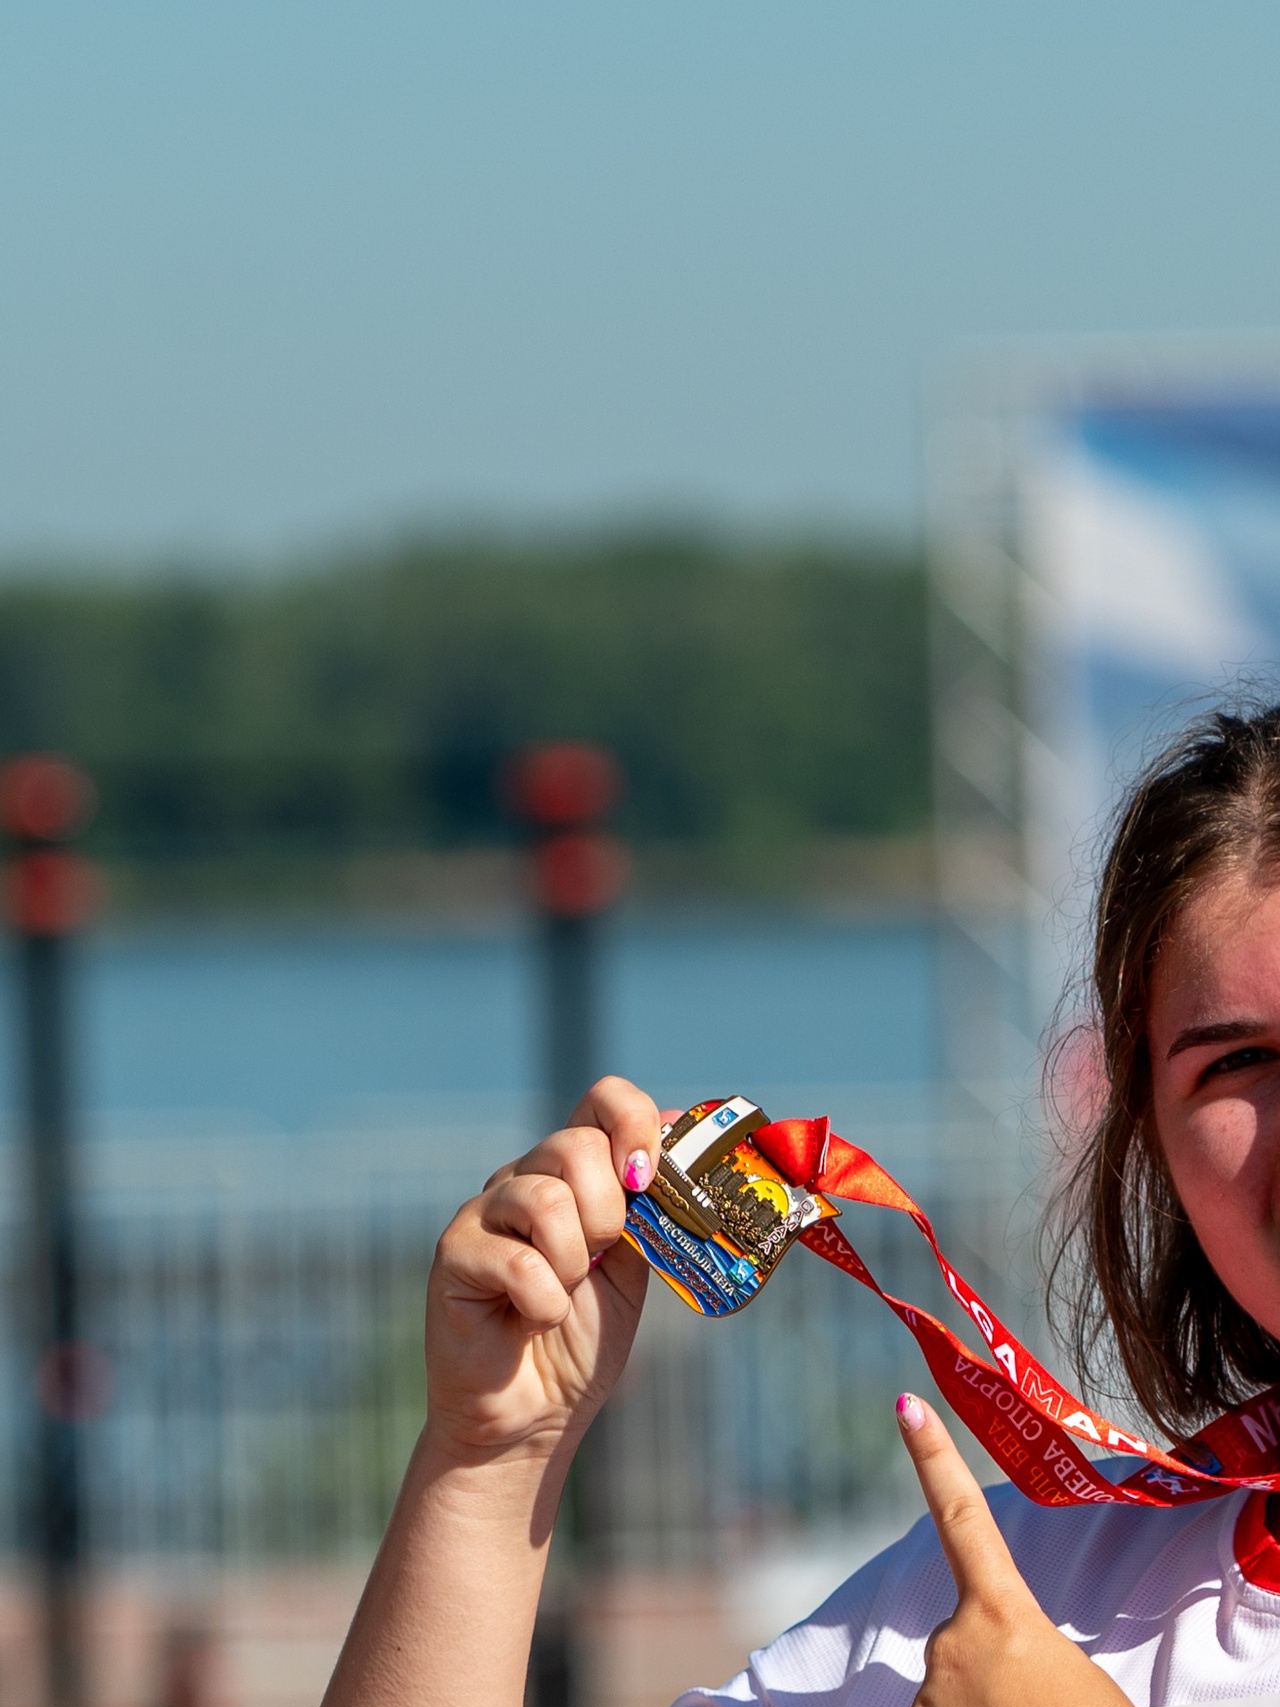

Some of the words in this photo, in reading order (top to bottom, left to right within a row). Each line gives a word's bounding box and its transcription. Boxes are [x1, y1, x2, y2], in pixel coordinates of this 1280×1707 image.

[626, 1208, 678, 1264] ОРОЛЕВА
[675, 1260, 722, 1311] СПОРТА
[658, 1215, 712, 1273] ФЕСТИВАЛЬ
[711, 1270, 736, 1297] БЕГА
[758, 1200, 815, 1255] САМАРА
[953, 1354, 1044, 1441] СПОРТА
[987, 1415, 1030, 1470] БЕГА
